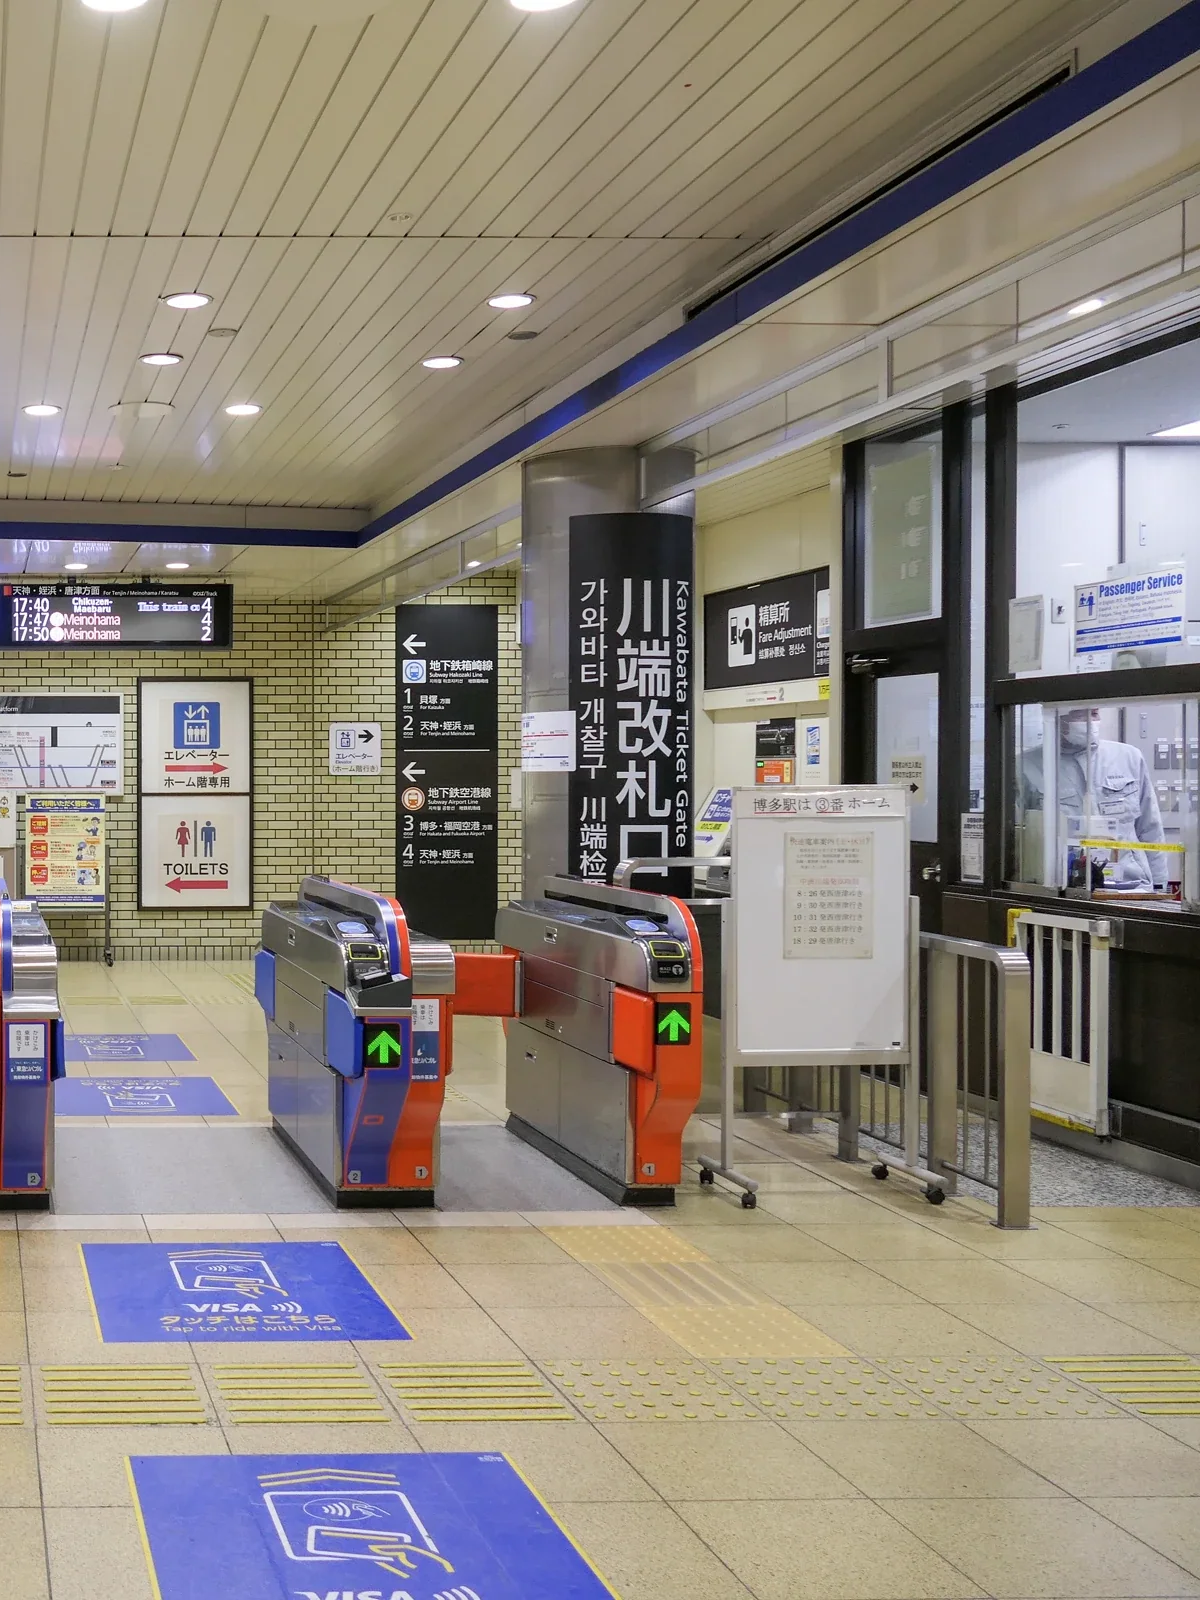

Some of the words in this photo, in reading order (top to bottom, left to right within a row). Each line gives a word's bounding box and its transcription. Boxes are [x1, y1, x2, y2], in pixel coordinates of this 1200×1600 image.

[12, 586, 100, 596] 天神・姪浜・唐津方面
[1099, 580, 1146, 598] Passenger
[1147, 573, 1183, 590] Service
[13, 597, 50, 612] 17:40
[71, 597, 113, 606] Chikuzen-
[137, 601, 160, 611] This
[162, 601, 188, 611] train
[201, 597, 212, 611] 4
[73, 605, 111, 613] Maebaru
[758, 601, 790, 627] 精算所
[13, 612, 50, 626] 17:47
[64, 613, 121, 626] Meinohama
[201, 612, 212, 626] 4
[13, 627, 50, 641] 17:50
[64, 627, 121, 640] Meinohama
[201, 626, 212, 641] 2
[579, 578, 607, 688] 가와바타
[758, 631, 773, 643] Fare
[773, 624, 812, 643] Adjustment
[676, 580, 690, 703] Kawabata
[429, 660, 494, 672] 地下鉄箱崎線
[403, 688, 411, 704] 1
[420, 695, 438, 705] 貝塚
[778, 687, 785, 701] 2
[403, 715, 414, 731] 2
[420, 721, 462, 731] 天神・姪浜
[616, 578, 672, 877] 川端改札口
[579, 698, 607, 780] 개찰구
[676, 714, 690, 783] Ticket
[163, 750, 230, 761] エレベーター
[331, 765, 380, 774] （ホーム階行き）
[163, 776, 230, 788] ホーム階専用
[428, 787, 492, 799] 地下鉄空港線
[753, 797, 812, 812] 博多駅は
[848, 797, 891, 809] ホーム
[403, 815, 414, 831] 3
[676, 790, 690, 848] Gate
[420, 821, 480, 831] 博多・福岡空港
[402, 844, 414, 859] 4
[419, 849, 461, 859] 天神・姪浜
[163, 863, 229, 876] TOILETS
[418, 1167, 424, 1177] 1
[646, 1164, 652, 1175] 1
[30, 1175, 36, 1184] 2
[352, 1173, 358, 1182] 2
[181, 1303, 263, 1313] VISA
[159, 1315, 337, 1325] タッチはこちら
[161, 1325, 194, 1333] Tap
